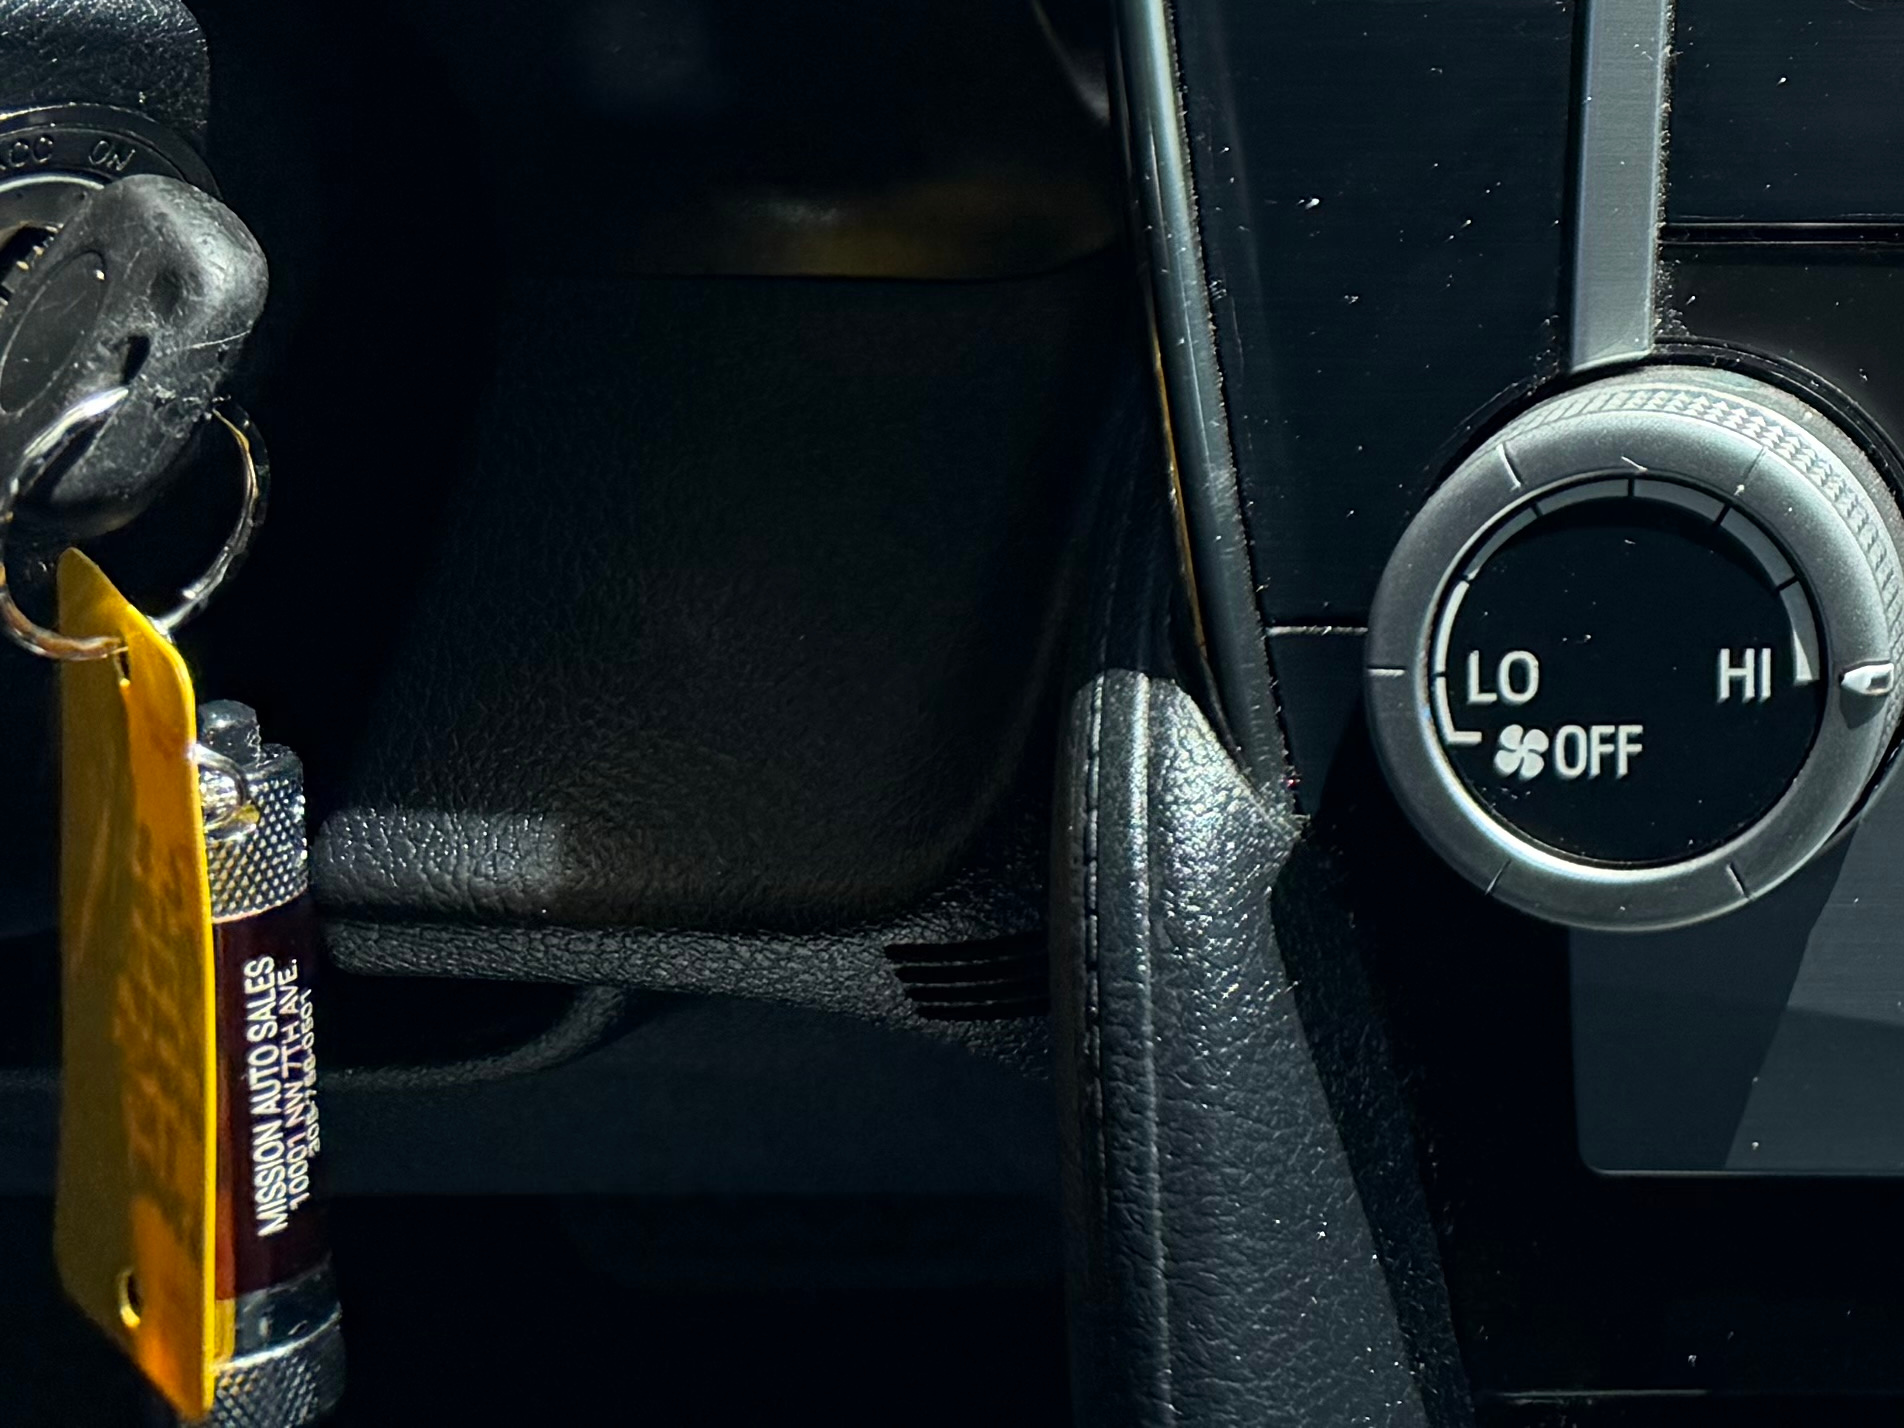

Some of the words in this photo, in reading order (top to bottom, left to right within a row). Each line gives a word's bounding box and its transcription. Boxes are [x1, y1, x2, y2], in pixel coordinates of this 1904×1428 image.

[1466, 649, 1540, 705] LO
[1716, 647, 1772, 704] HI
[1553, 723, 1644, 781] OFF
[242, 955, 280, 1042] SALES
[276, 958, 300, 1015] AVE.
[279, 1021, 303, 1079] 7TH
[246, 1044, 283, 1115] AUTO
[283, 1080, 307, 1128] NW
[252, 1119, 289, 1237] MISSION
[287, 1132, 311, 1210] 10001
